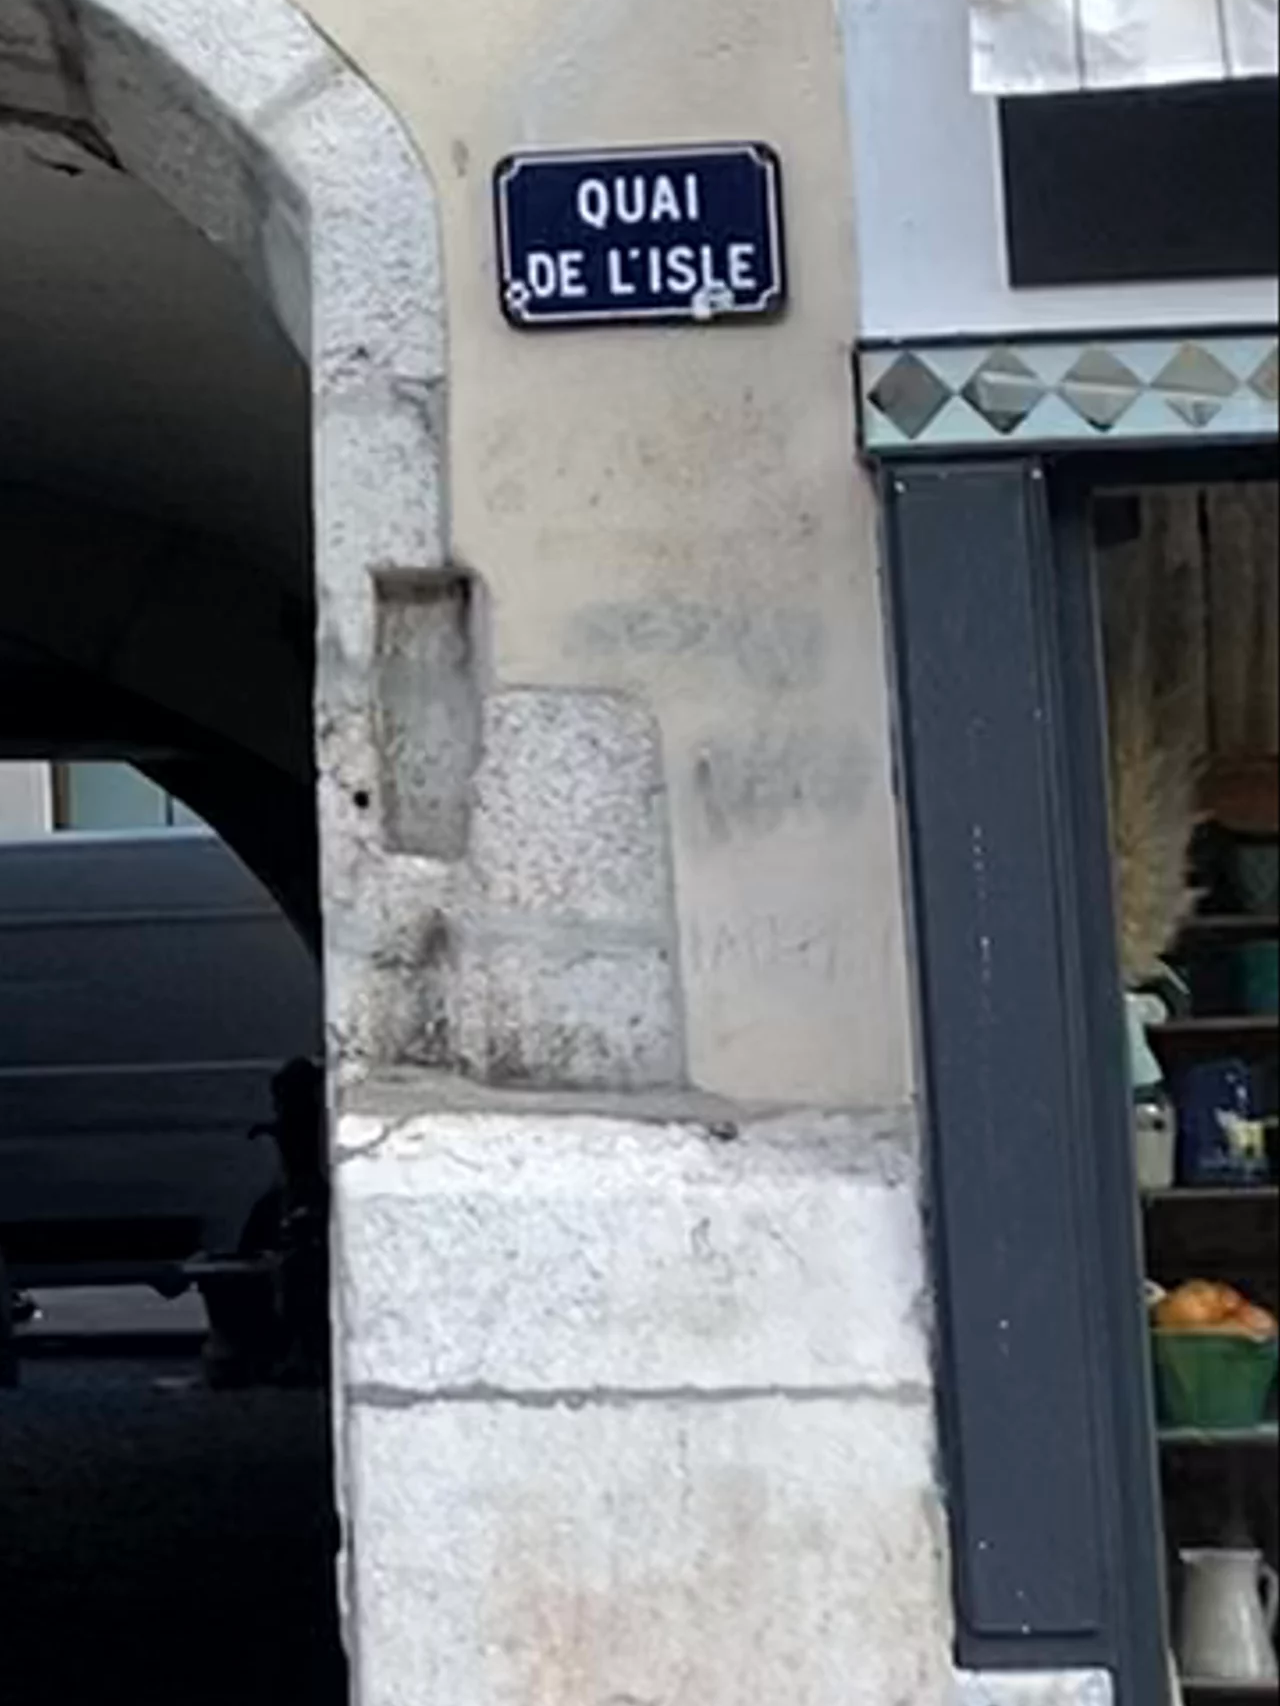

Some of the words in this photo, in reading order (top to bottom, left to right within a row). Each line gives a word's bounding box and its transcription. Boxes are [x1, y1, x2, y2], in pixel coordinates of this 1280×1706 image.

[577, 173, 699, 230] QUAI
[527, 250, 587, 298] DE
[608, 242, 757, 296] L'ISLE
